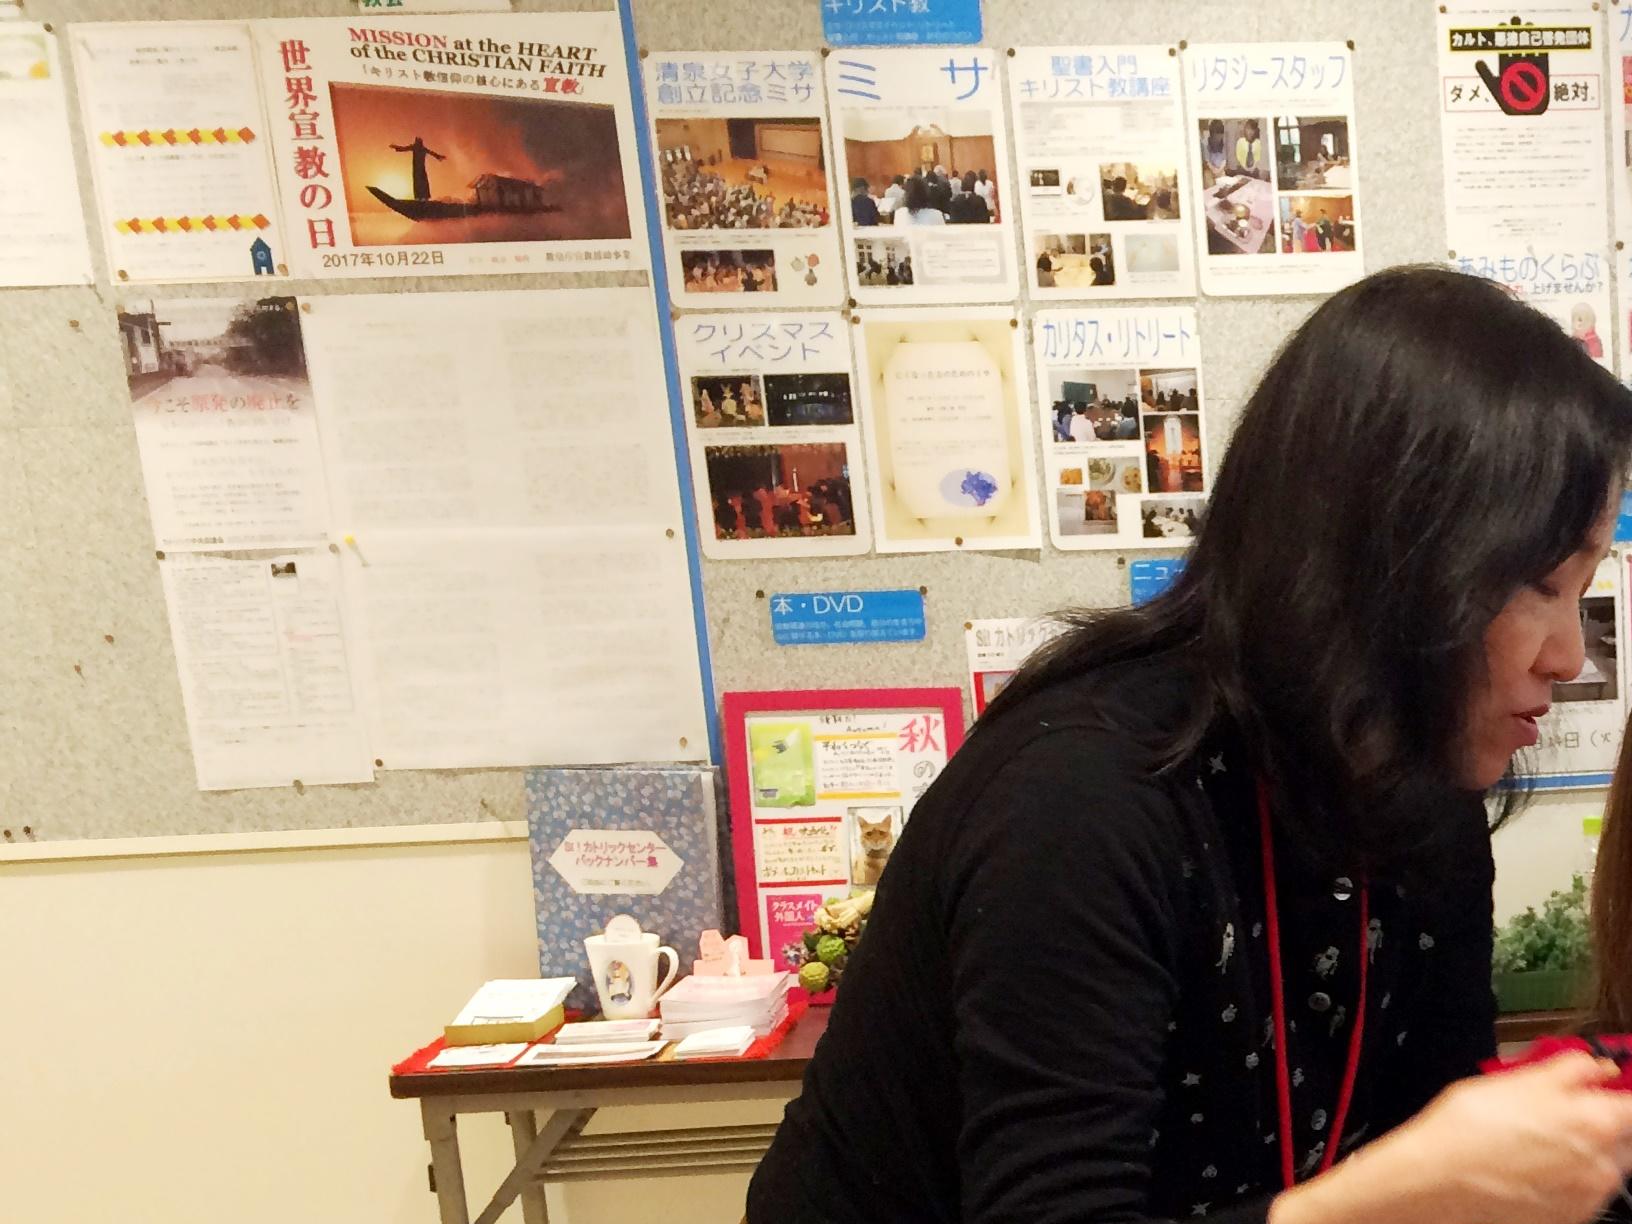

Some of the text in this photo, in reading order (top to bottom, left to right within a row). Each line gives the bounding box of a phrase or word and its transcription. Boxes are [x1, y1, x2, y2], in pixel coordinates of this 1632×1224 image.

[347, 27, 598, 62] MISSION at the HEART
[350, 45, 608, 79] of the CHRISTIAN FAITH
[655, 60, 814, 83] 清泉女子大学
[1050, 55, 1138, 76] 聖書入門
[1192, 54, 1346, 92] リタジースタッフ
[657, 83, 815, 105] 創立記念ミサ
[1020, 77, 1171, 98] キリスト教講座
[279, 39, 336, 249] 世界宣教の日
[322, 250, 445, 269] 2017年10月22日
[1457, 253, 1599, 283] あみものくらぶ
[694, 320, 834, 343] クリスマス
[1042, 318, 1191, 360] カリタス・リトリート
[710, 342, 822, 364] イベント
